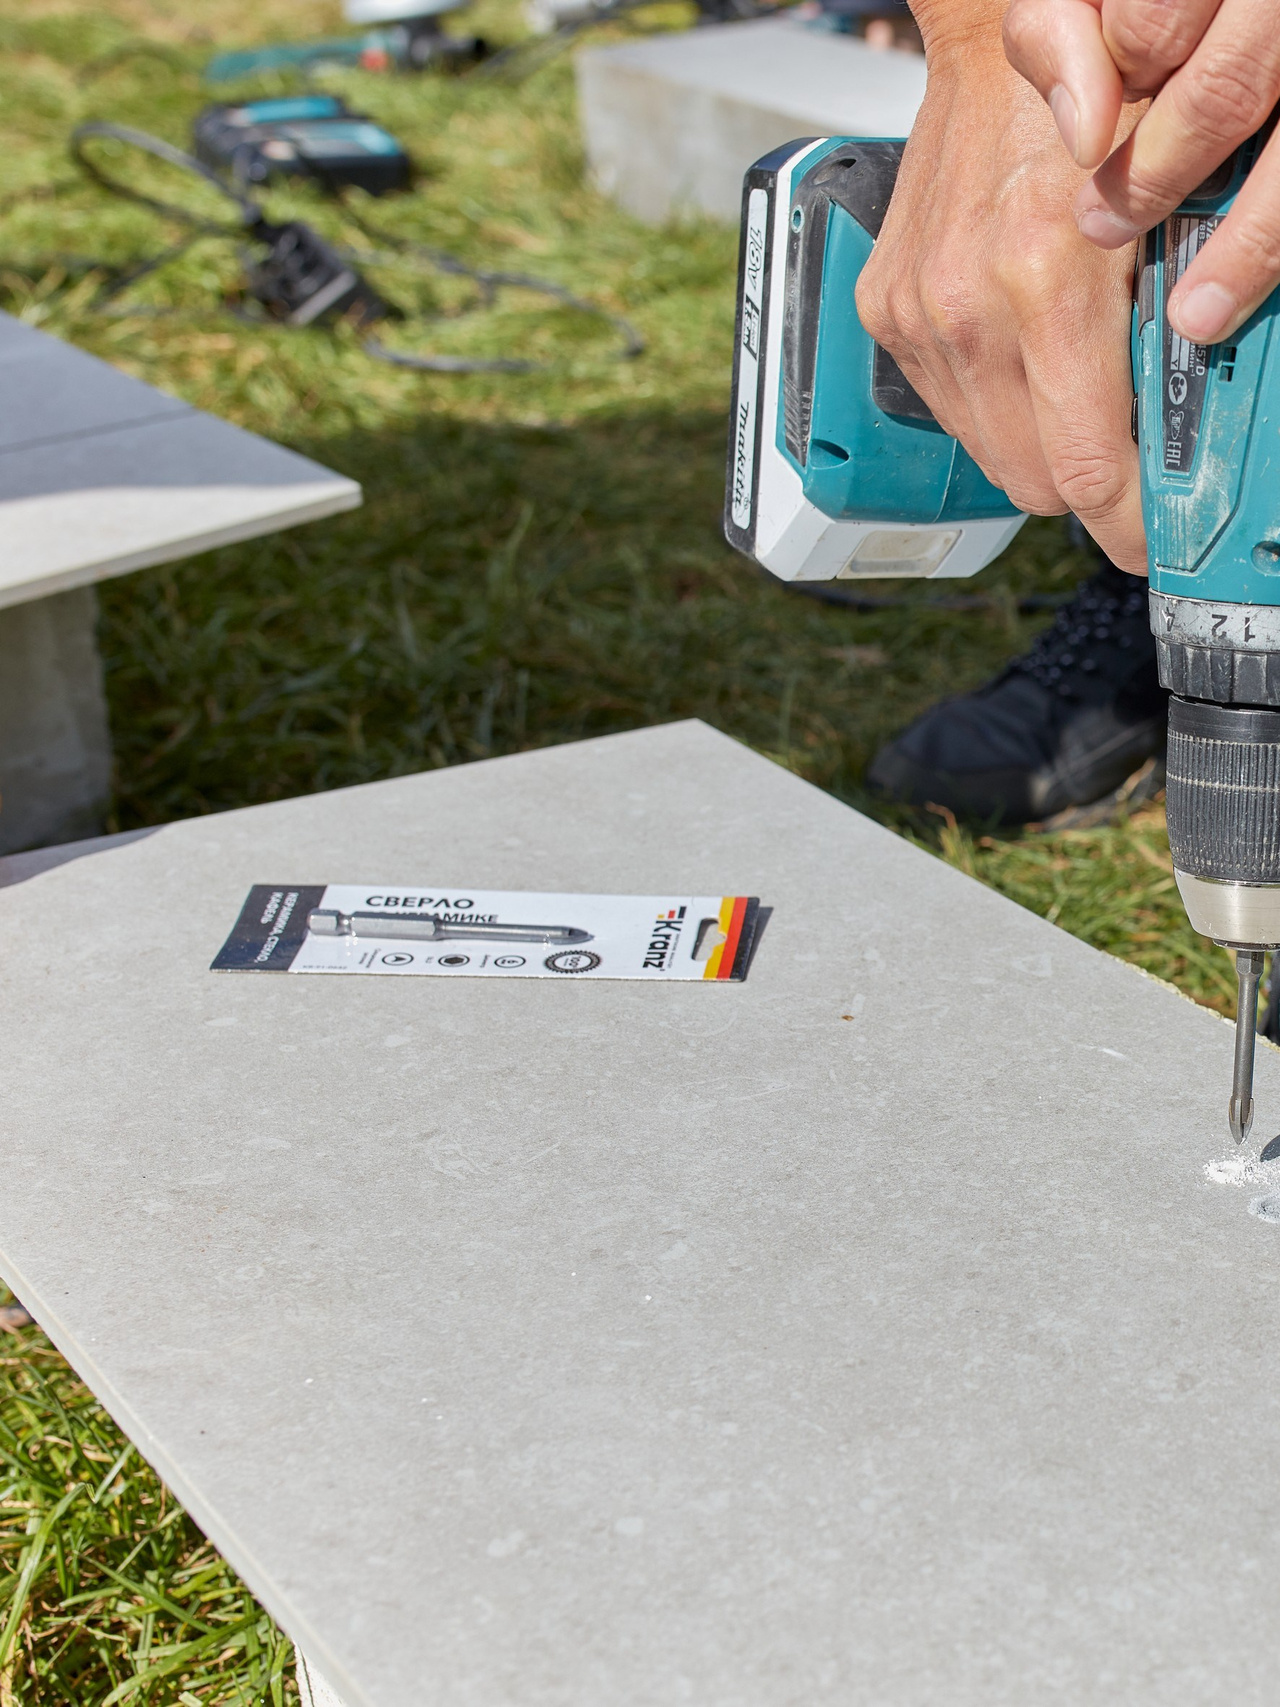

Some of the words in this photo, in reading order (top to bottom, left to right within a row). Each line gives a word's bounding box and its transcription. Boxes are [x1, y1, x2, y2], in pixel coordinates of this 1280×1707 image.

[1195, 343, 1206, 376] 457D
[734, 400, 750, 508] makita
[1166, 440, 1182, 467] EAC
[1210, 613, 1228, 637] 2
[366, 895, 475, 910] СВЕРЛО
[643, 920, 684, 968] Kranz
